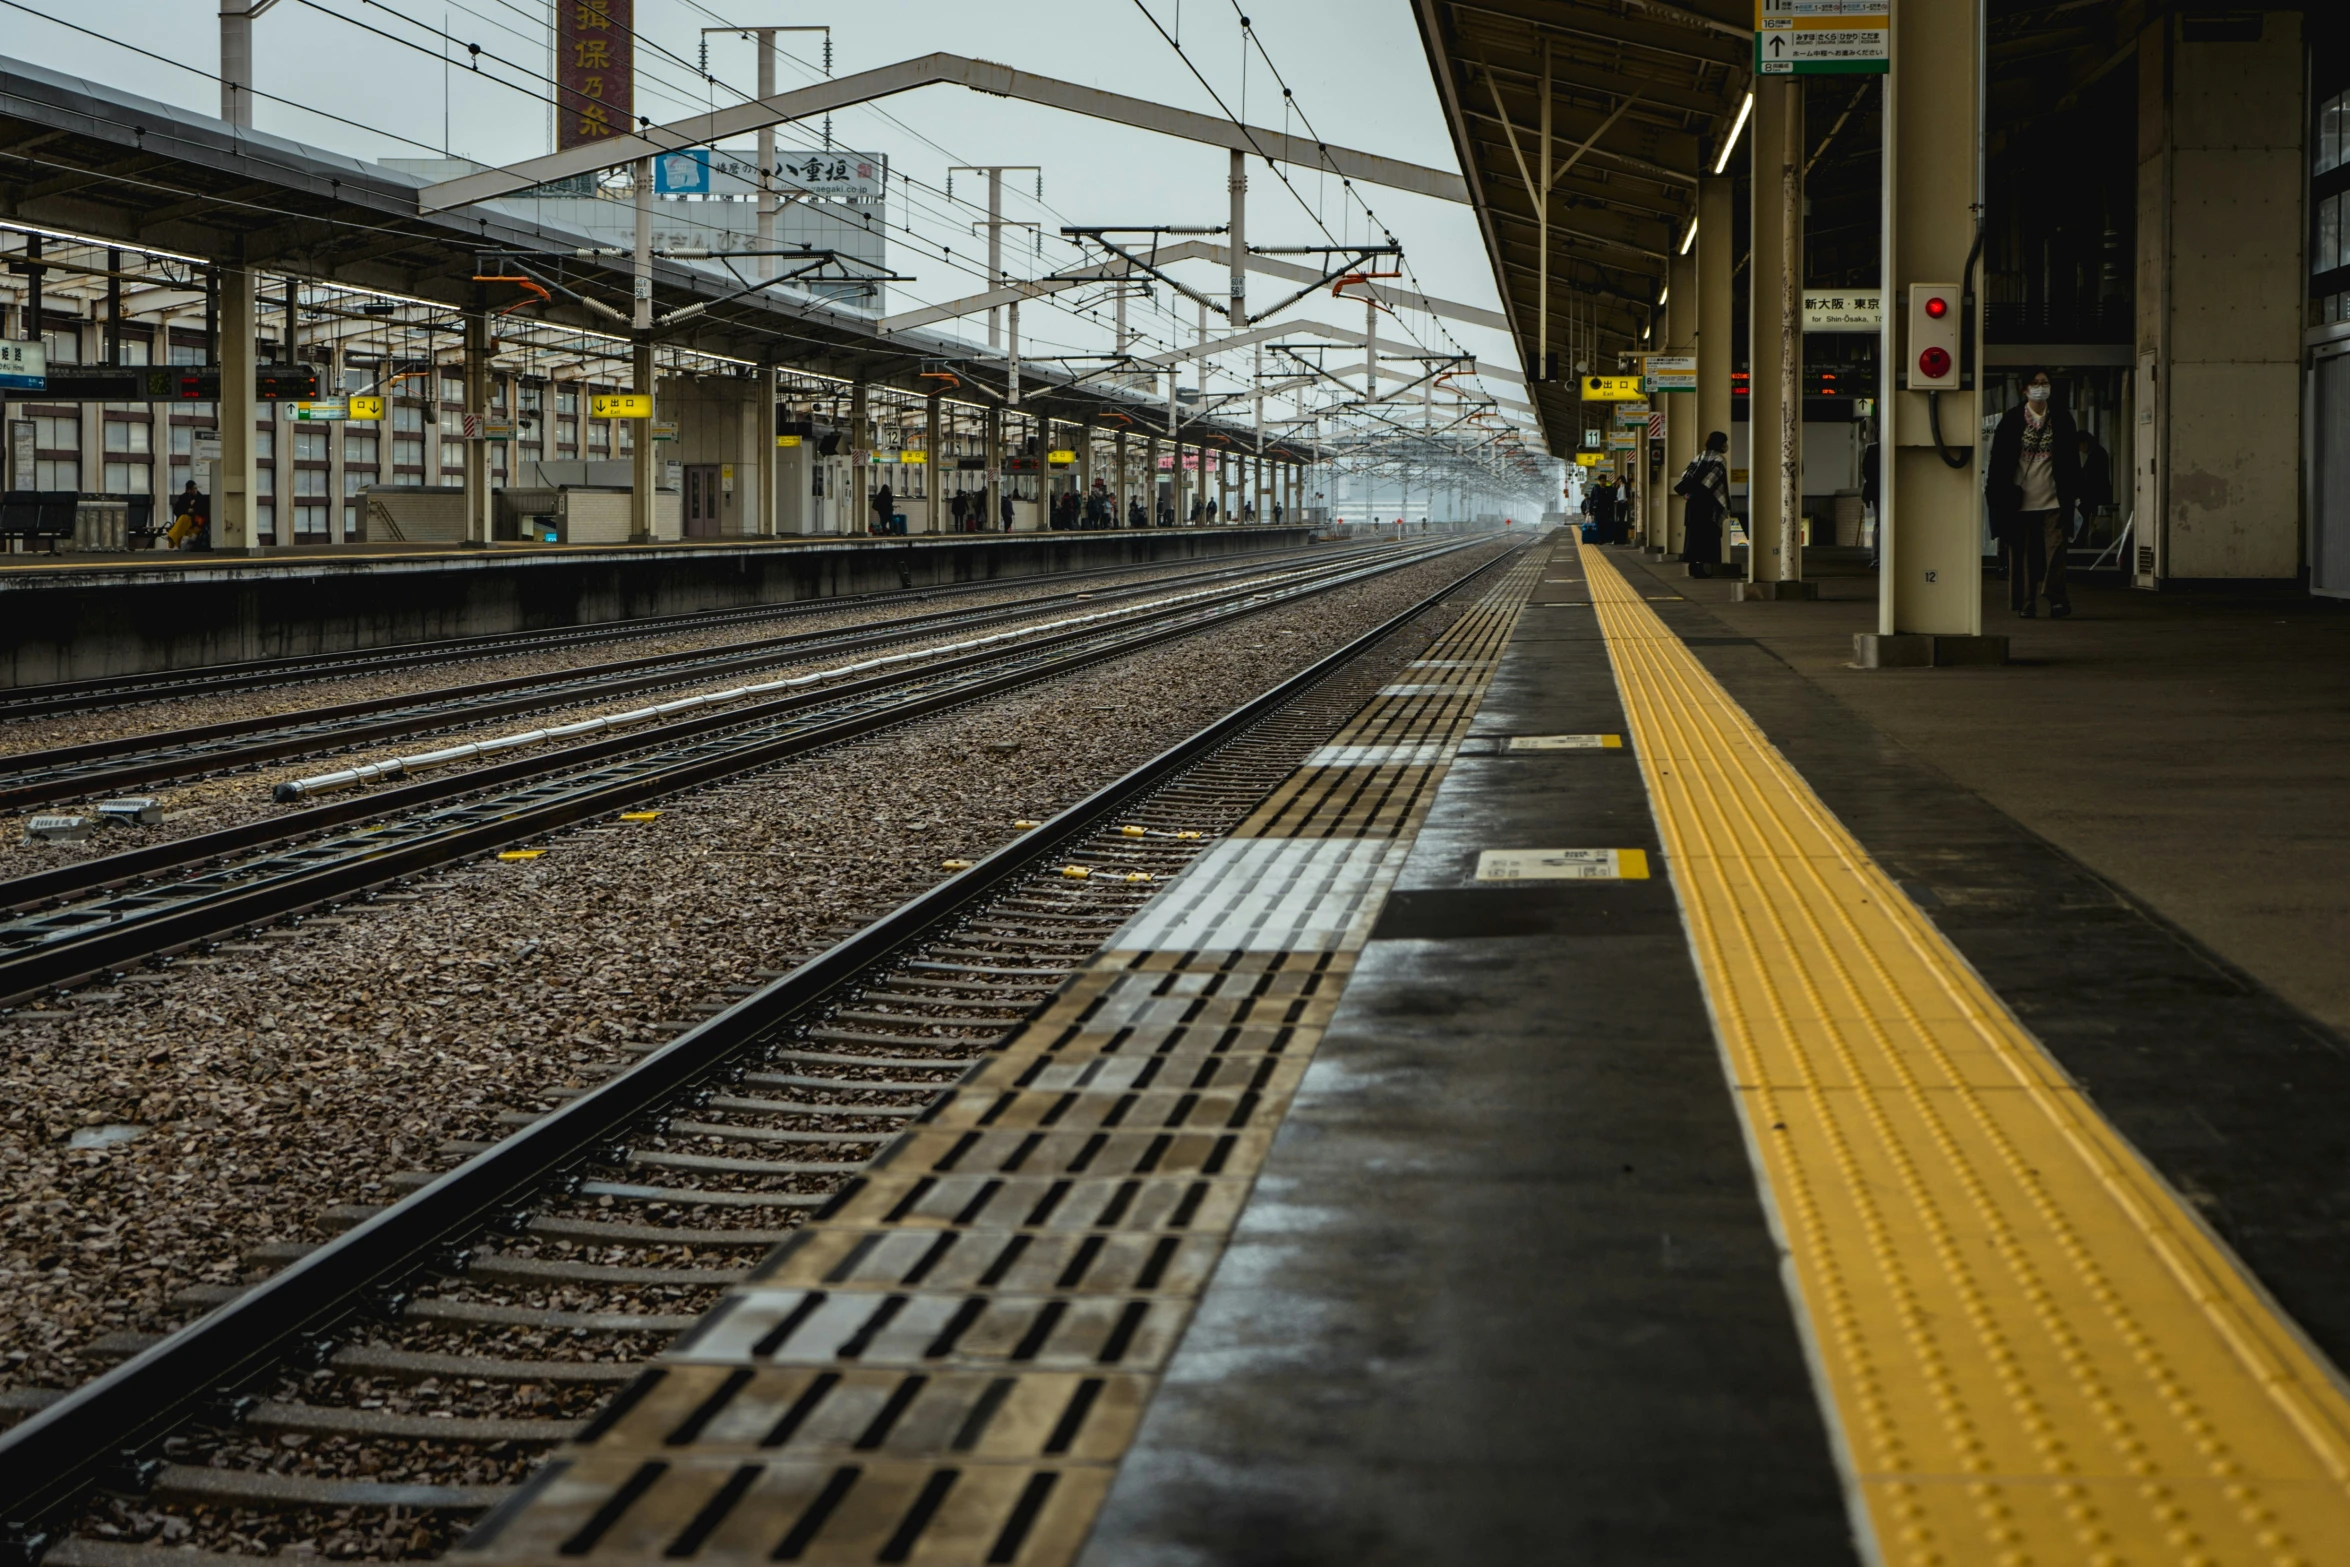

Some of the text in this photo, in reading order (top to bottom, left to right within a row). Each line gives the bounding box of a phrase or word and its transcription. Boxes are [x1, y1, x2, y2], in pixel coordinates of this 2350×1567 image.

[775, 157, 850, 182] 八重垣
[1603, 380, 1628, 389] 出口
[610, 399, 633, 407] 出口
[887, 431, 898, 444] 12
[1588, 432, 1598, 445] 11
[1925, 571, 1936, 583] 12
